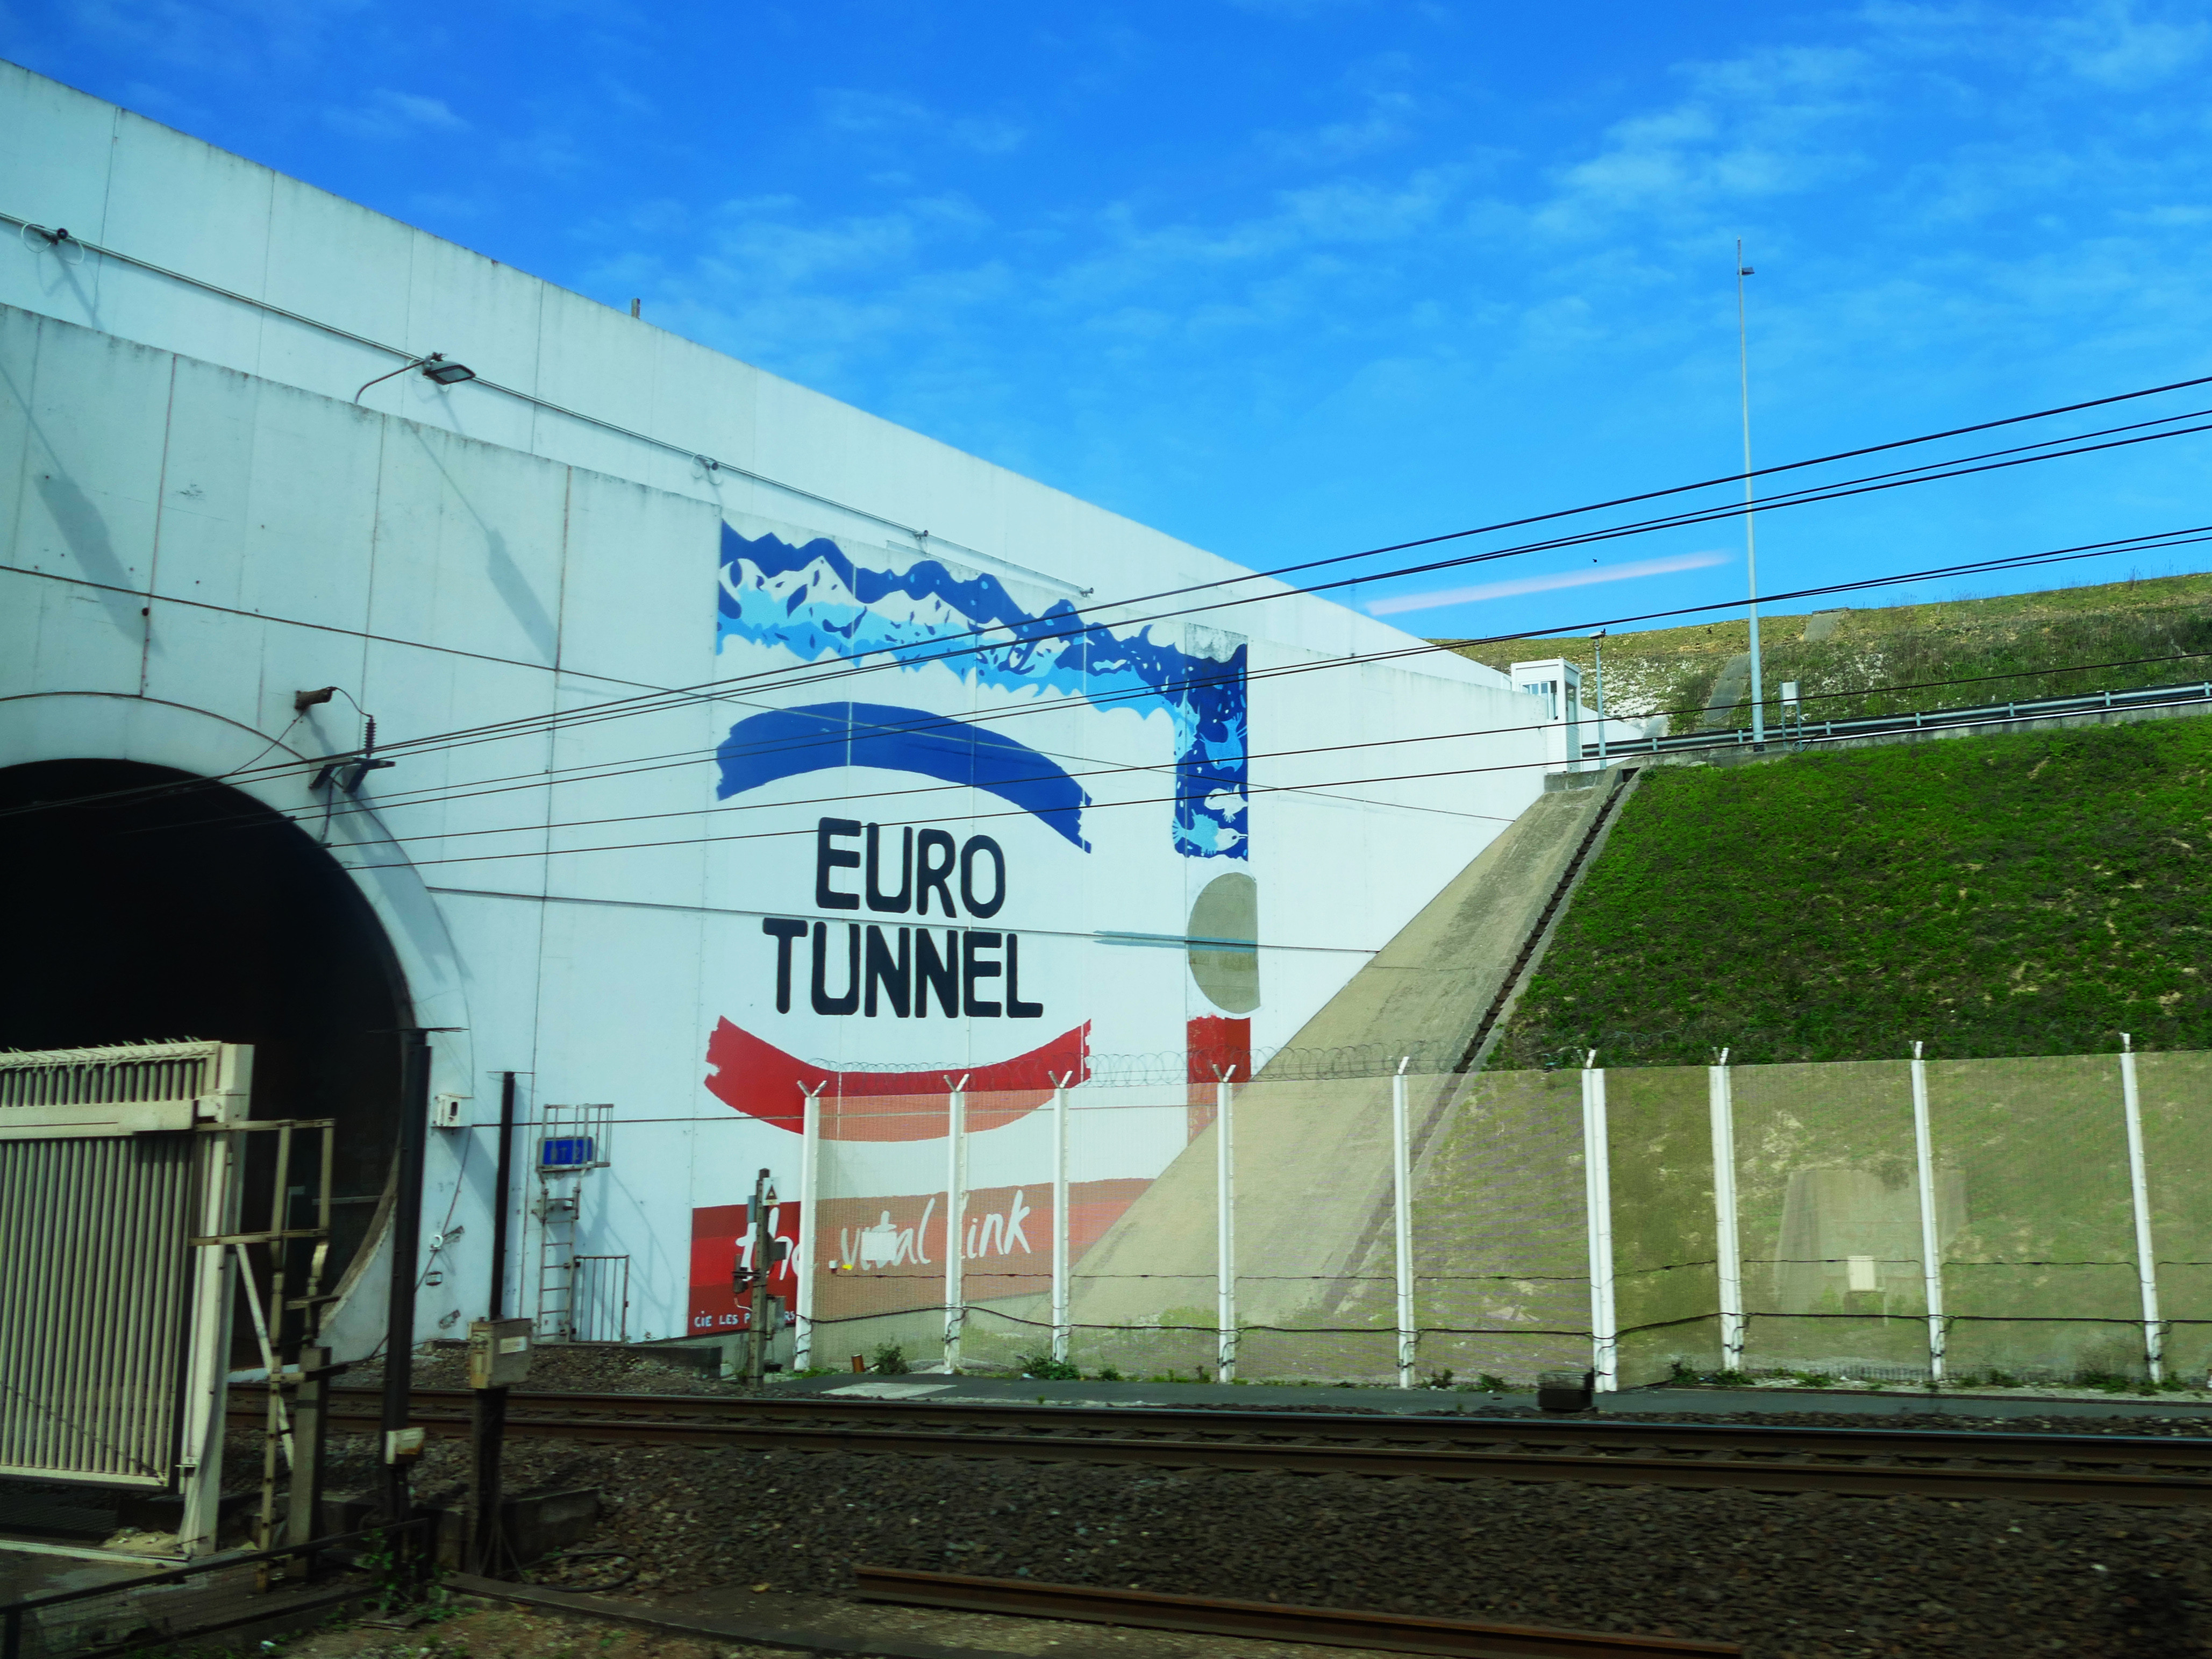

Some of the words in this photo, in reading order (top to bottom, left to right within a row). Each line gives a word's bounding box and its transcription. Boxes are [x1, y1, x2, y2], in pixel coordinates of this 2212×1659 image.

[816, 817, 1005, 918] EURO
[762, 917, 1043, 1018] TUNNEL
[960, 1190, 1031, 1259] ink
[719, 1314, 739, 1325] LES
